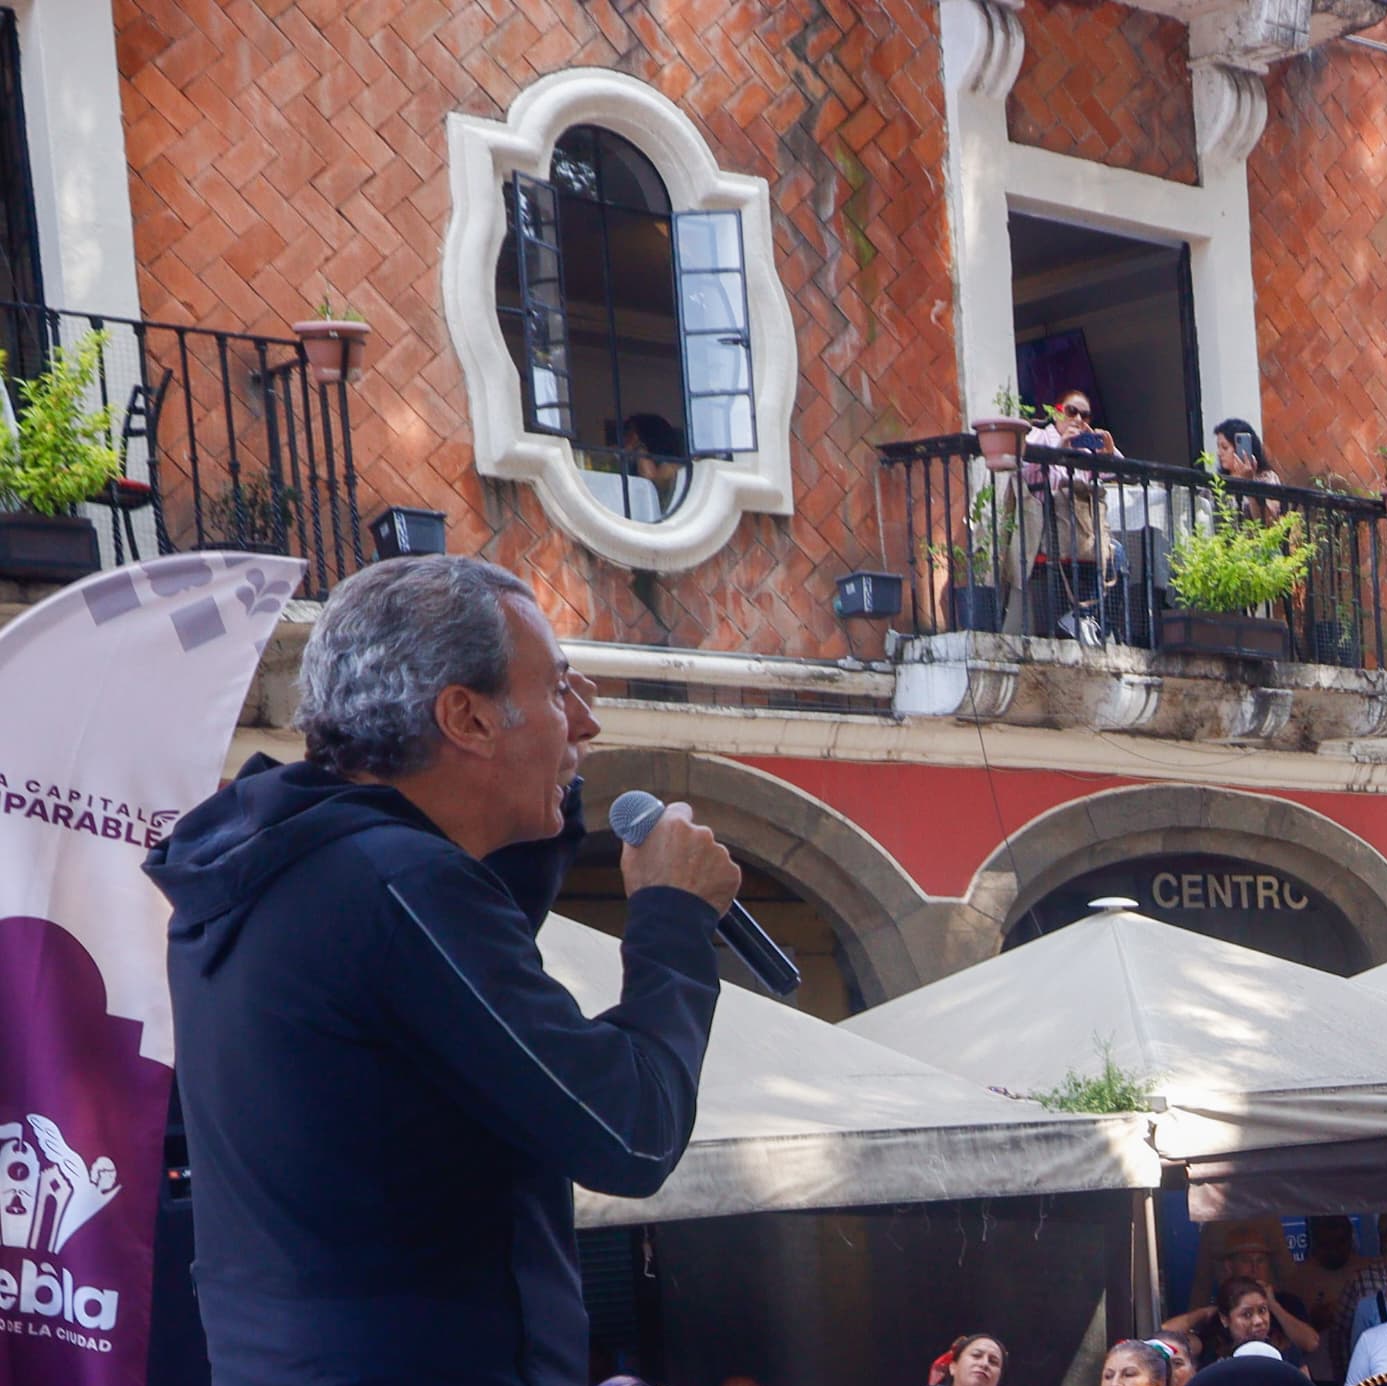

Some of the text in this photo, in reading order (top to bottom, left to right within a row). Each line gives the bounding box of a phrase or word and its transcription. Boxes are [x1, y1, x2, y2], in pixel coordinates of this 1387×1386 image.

[25, 779, 147, 825] CAPITAL
[28, 1322, 52, 1338] LA
[55, 1326, 113, 1353] CIUDAD
